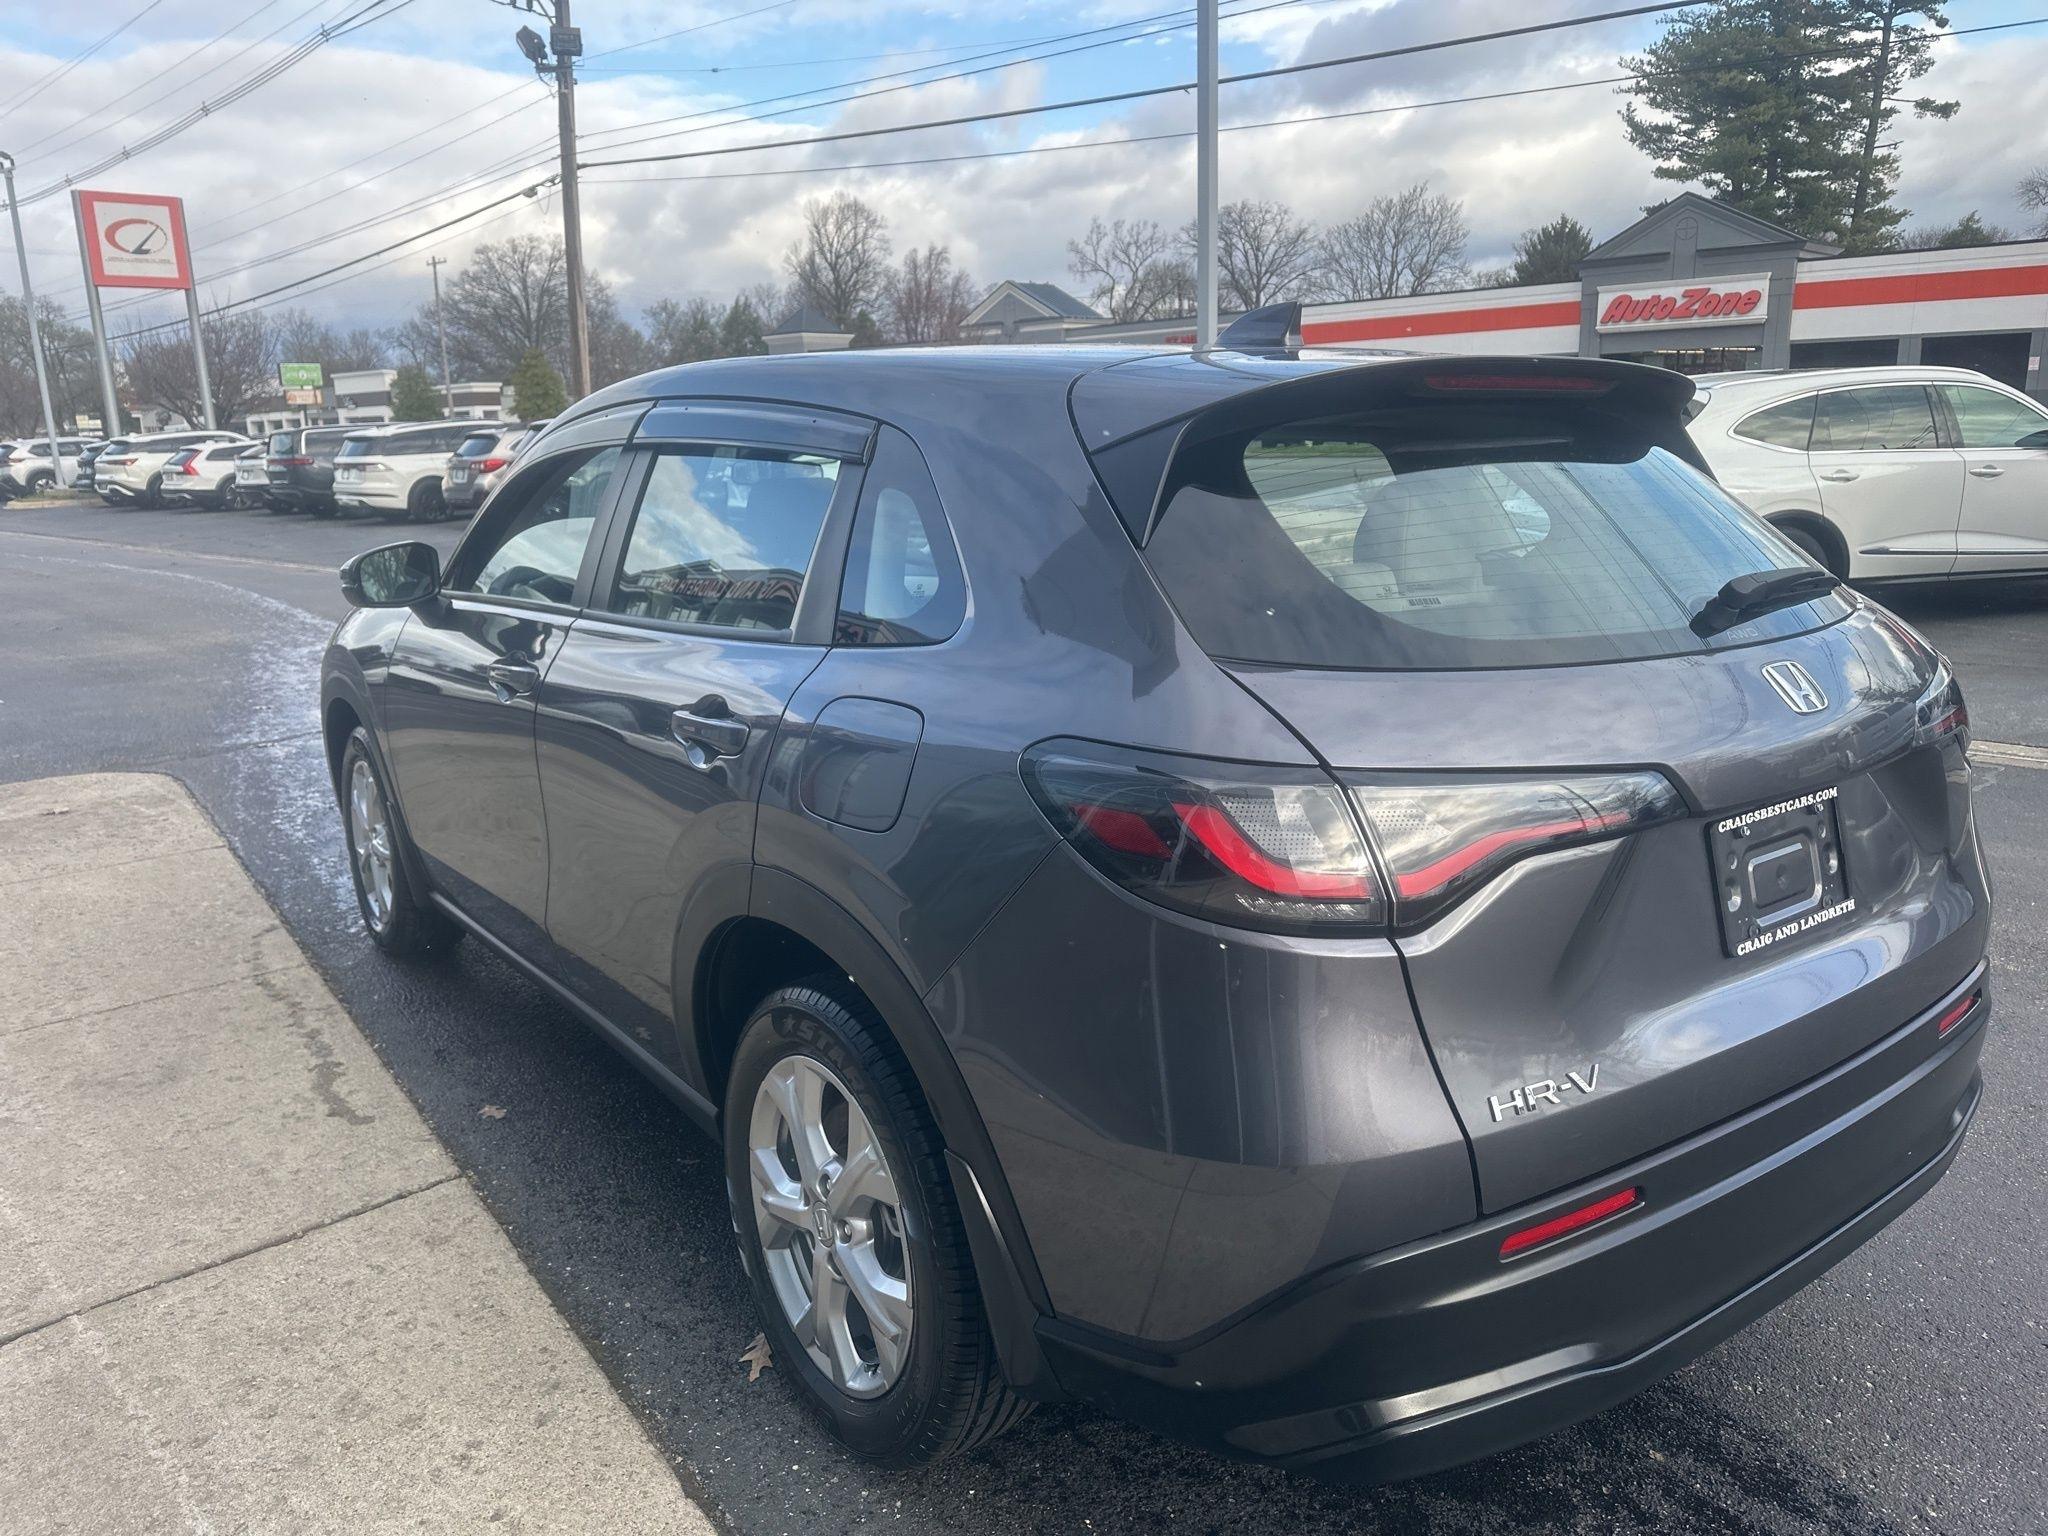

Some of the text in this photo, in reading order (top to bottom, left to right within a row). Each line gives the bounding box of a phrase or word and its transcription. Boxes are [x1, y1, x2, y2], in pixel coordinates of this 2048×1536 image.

[1601, 287, 1762, 324] AutoZone
[1727, 627, 1759, 641] AWD
[1718, 786, 1838, 833] CRAIGSBESTCARS.COM
[1737, 899, 1856, 956] CRAIG AND LANDRETH
[1487, 1063, 1599, 1122] HR-V
